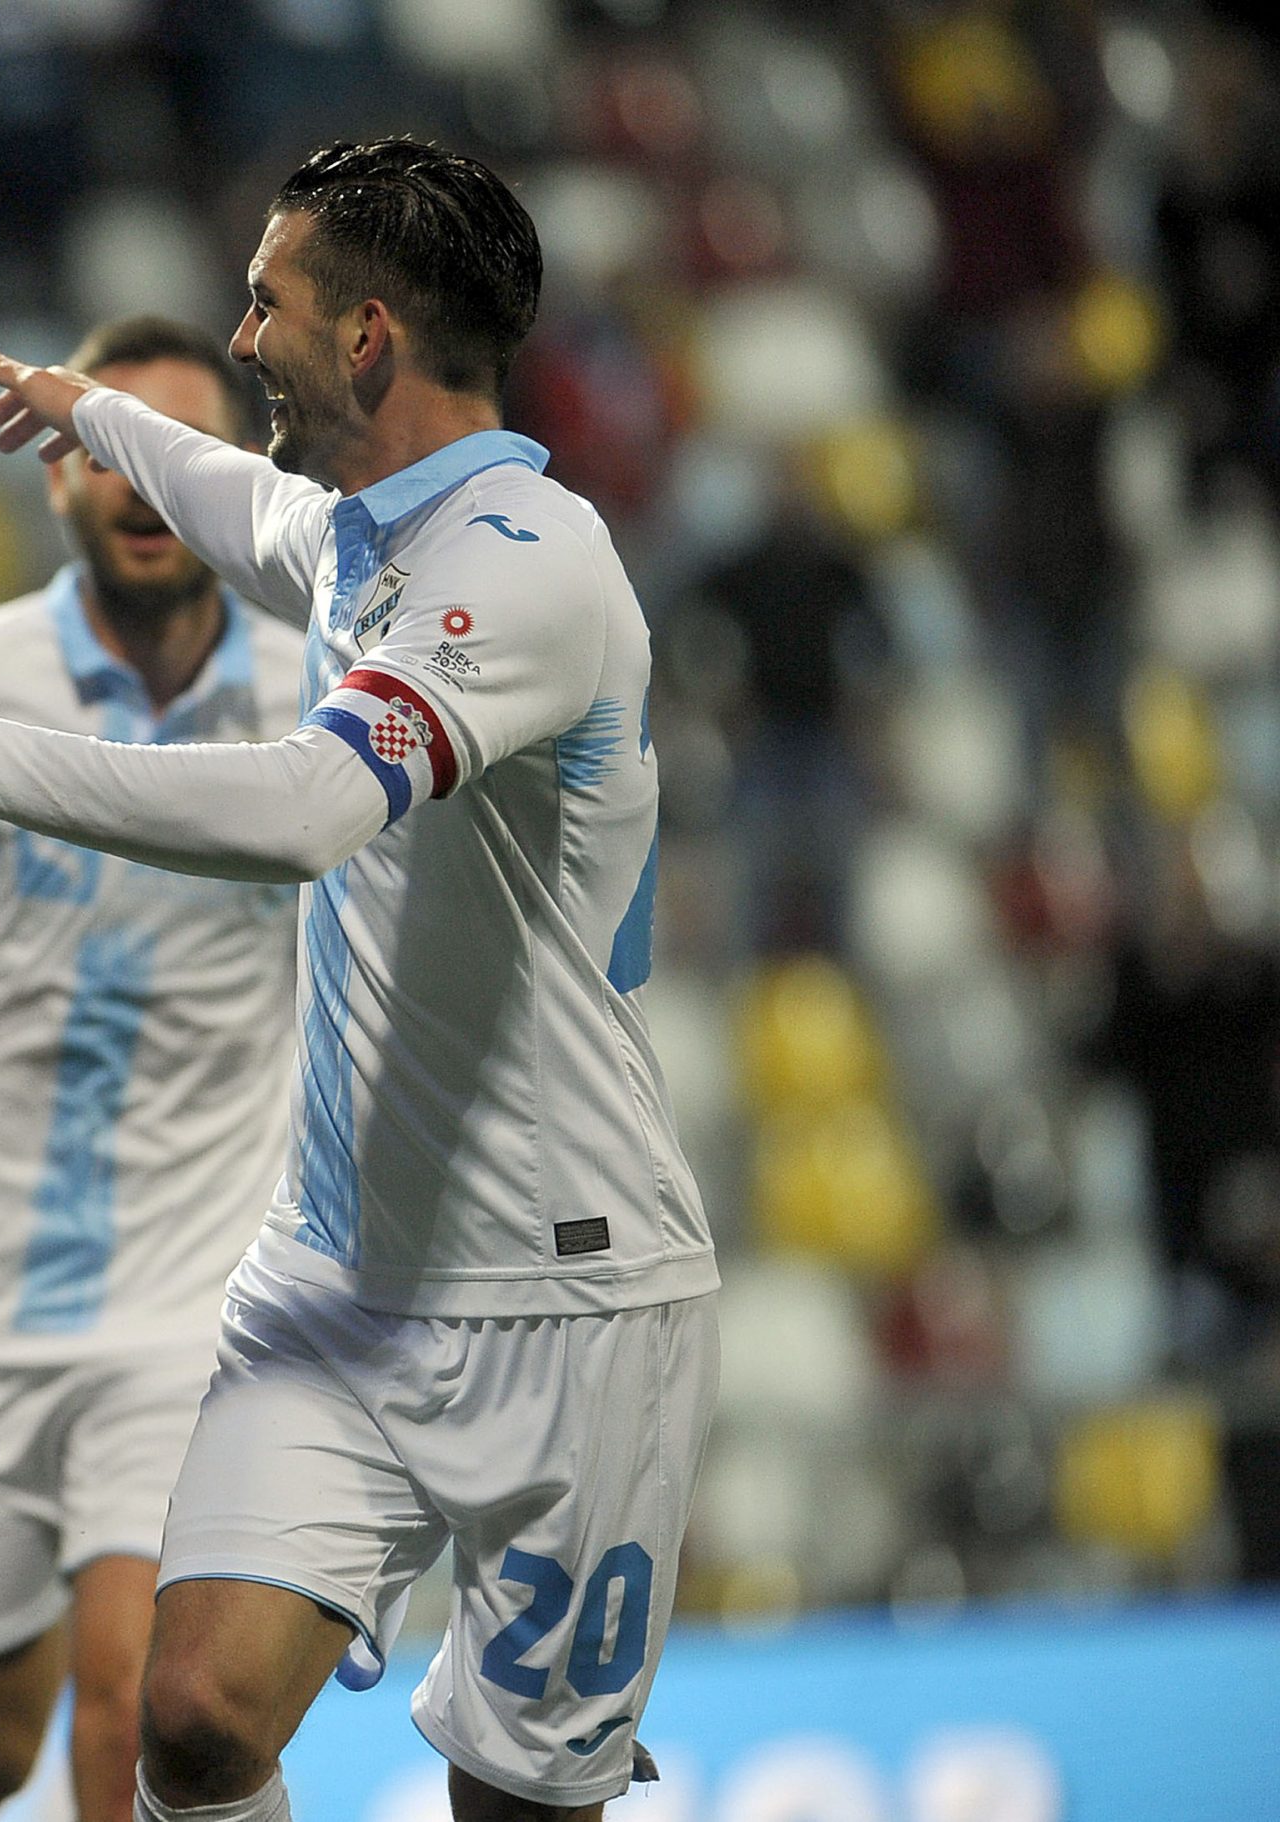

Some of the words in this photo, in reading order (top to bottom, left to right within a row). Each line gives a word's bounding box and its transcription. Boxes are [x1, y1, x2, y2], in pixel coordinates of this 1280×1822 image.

[361, 589, 401, 632] RIJE
[430, 651, 467, 675] 2020
[438, 641, 481, 676] RIJEKA
[480, 1541, 654, 1700] 20
